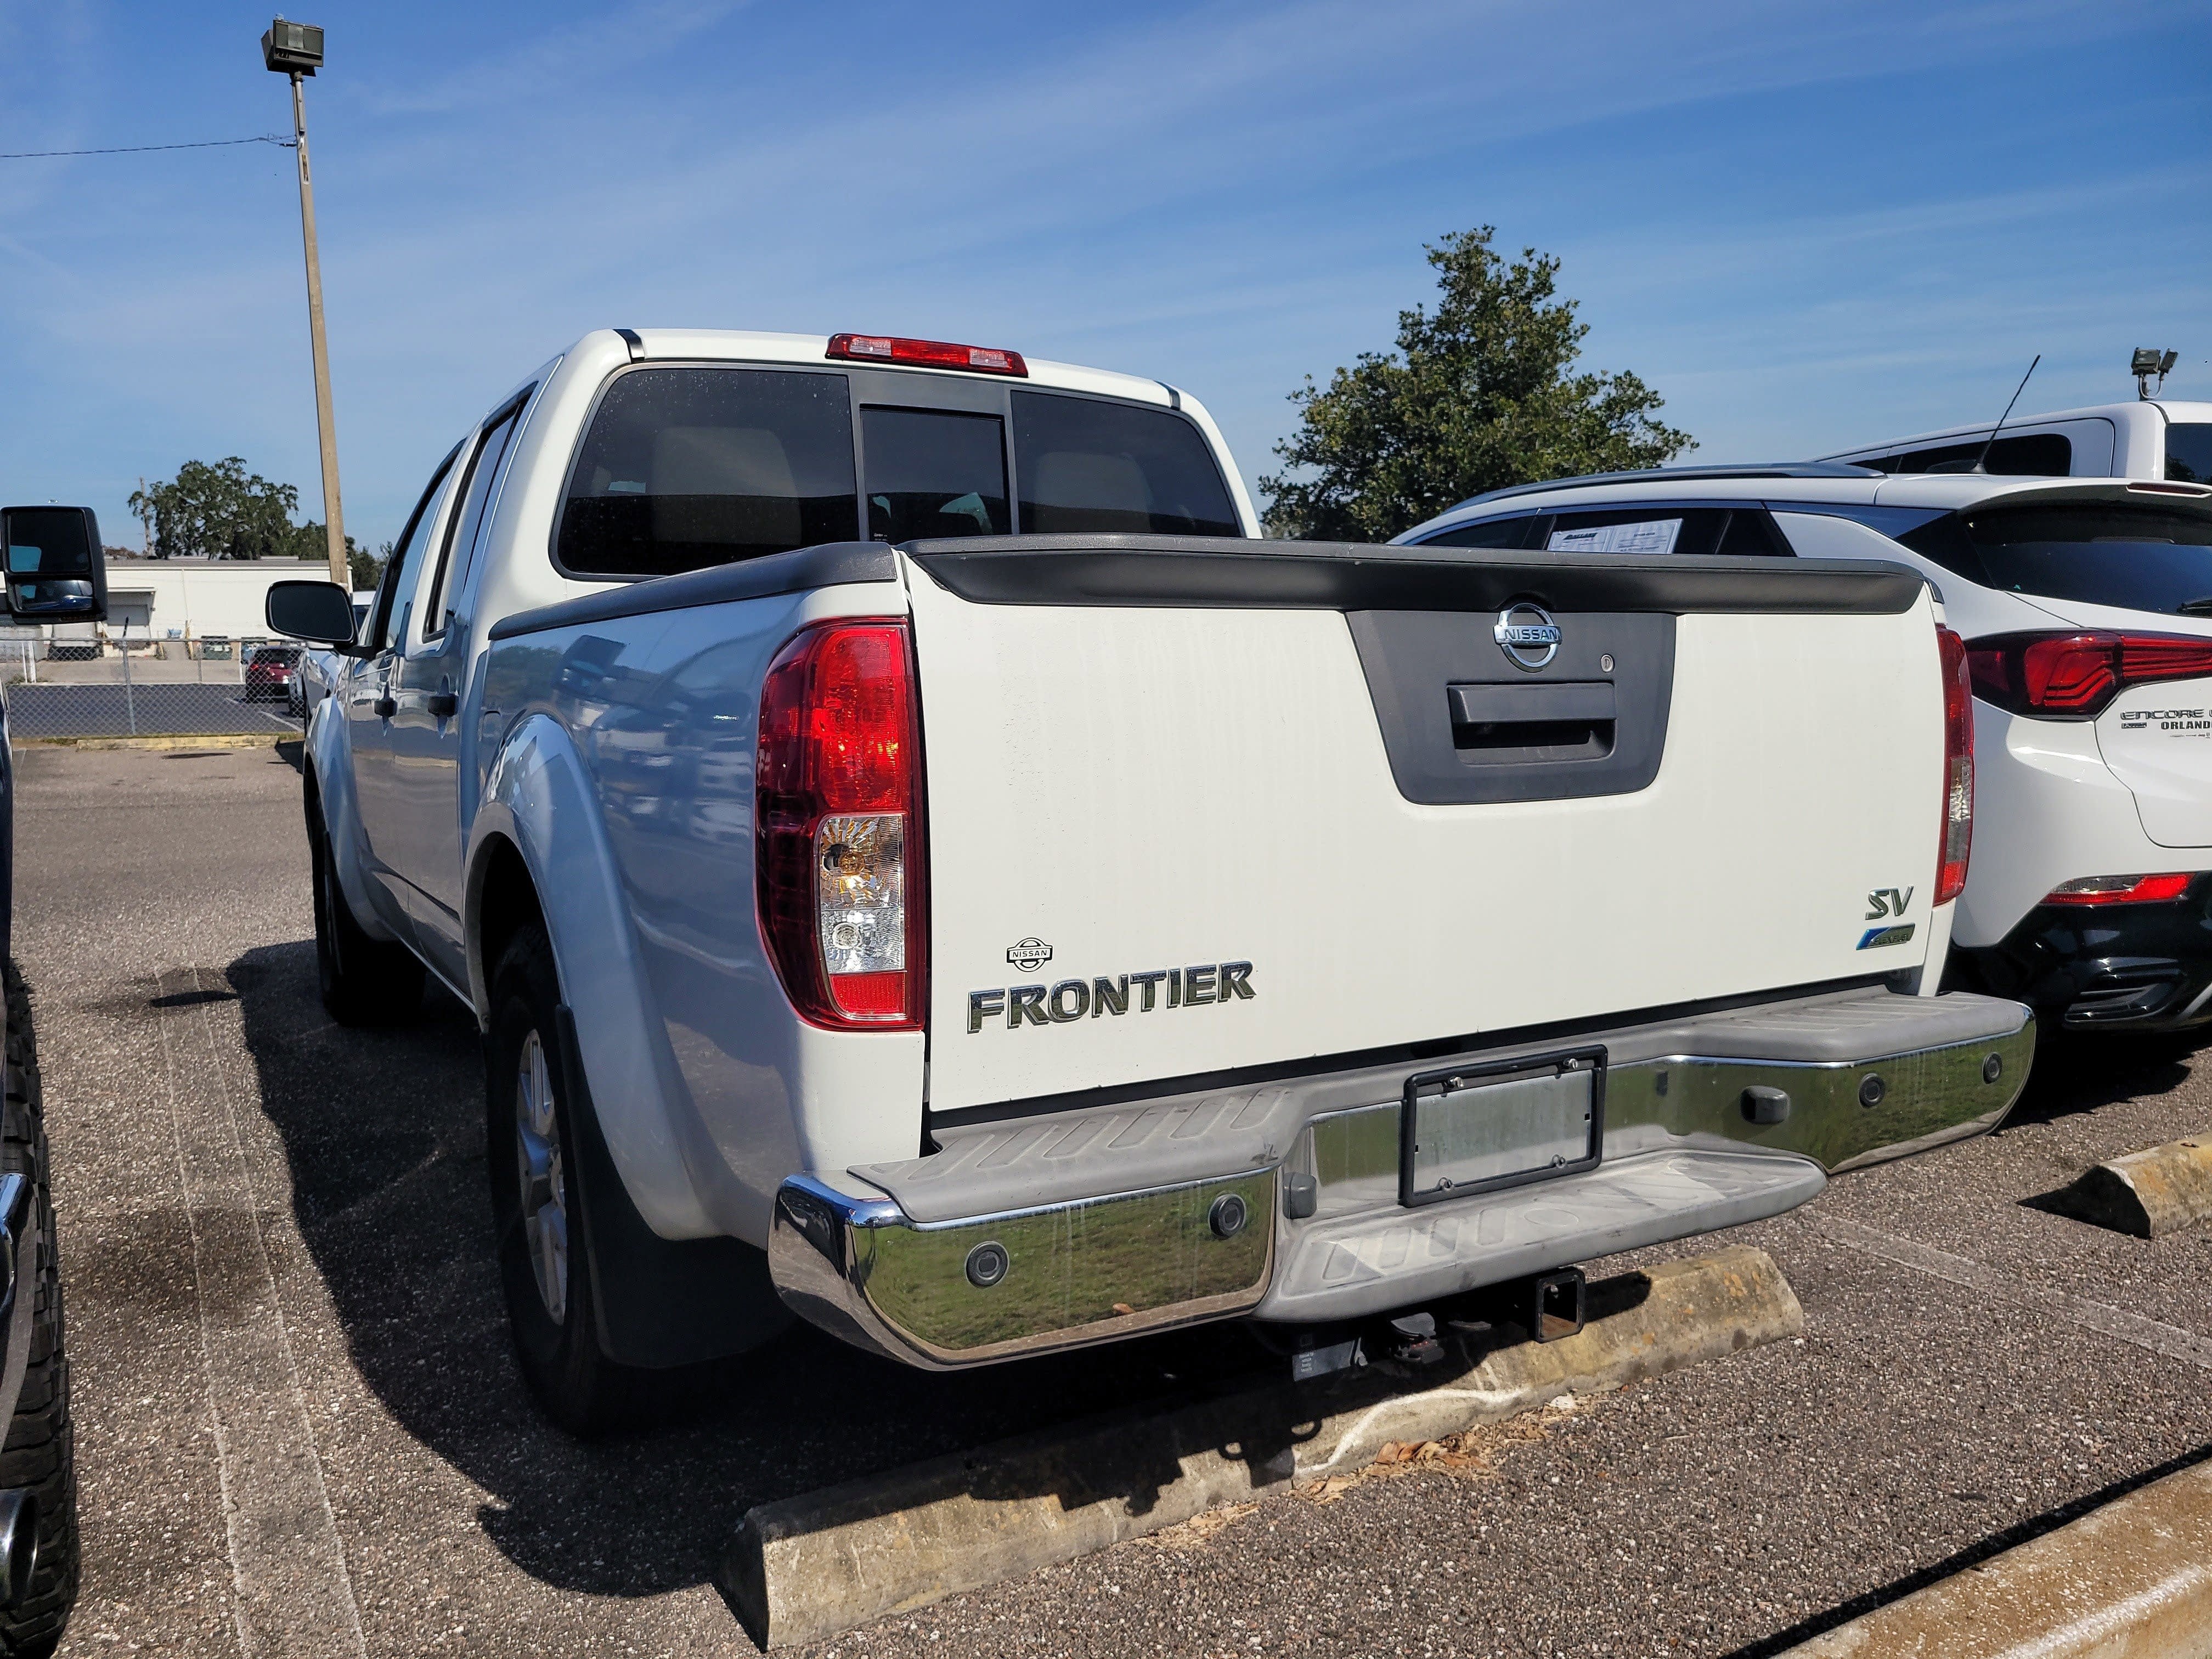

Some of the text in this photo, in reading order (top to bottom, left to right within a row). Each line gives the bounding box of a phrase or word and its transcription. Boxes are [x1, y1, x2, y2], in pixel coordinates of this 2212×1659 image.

[1504, 629, 1558, 641] NISSAN
[2120, 709, 2204, 720] ENCORE
[2160, 721, 2212, 730] ORLAND
[1865, 885, 1915, 920] SV
[967, 960, 1257, 1034] FRONTIER
